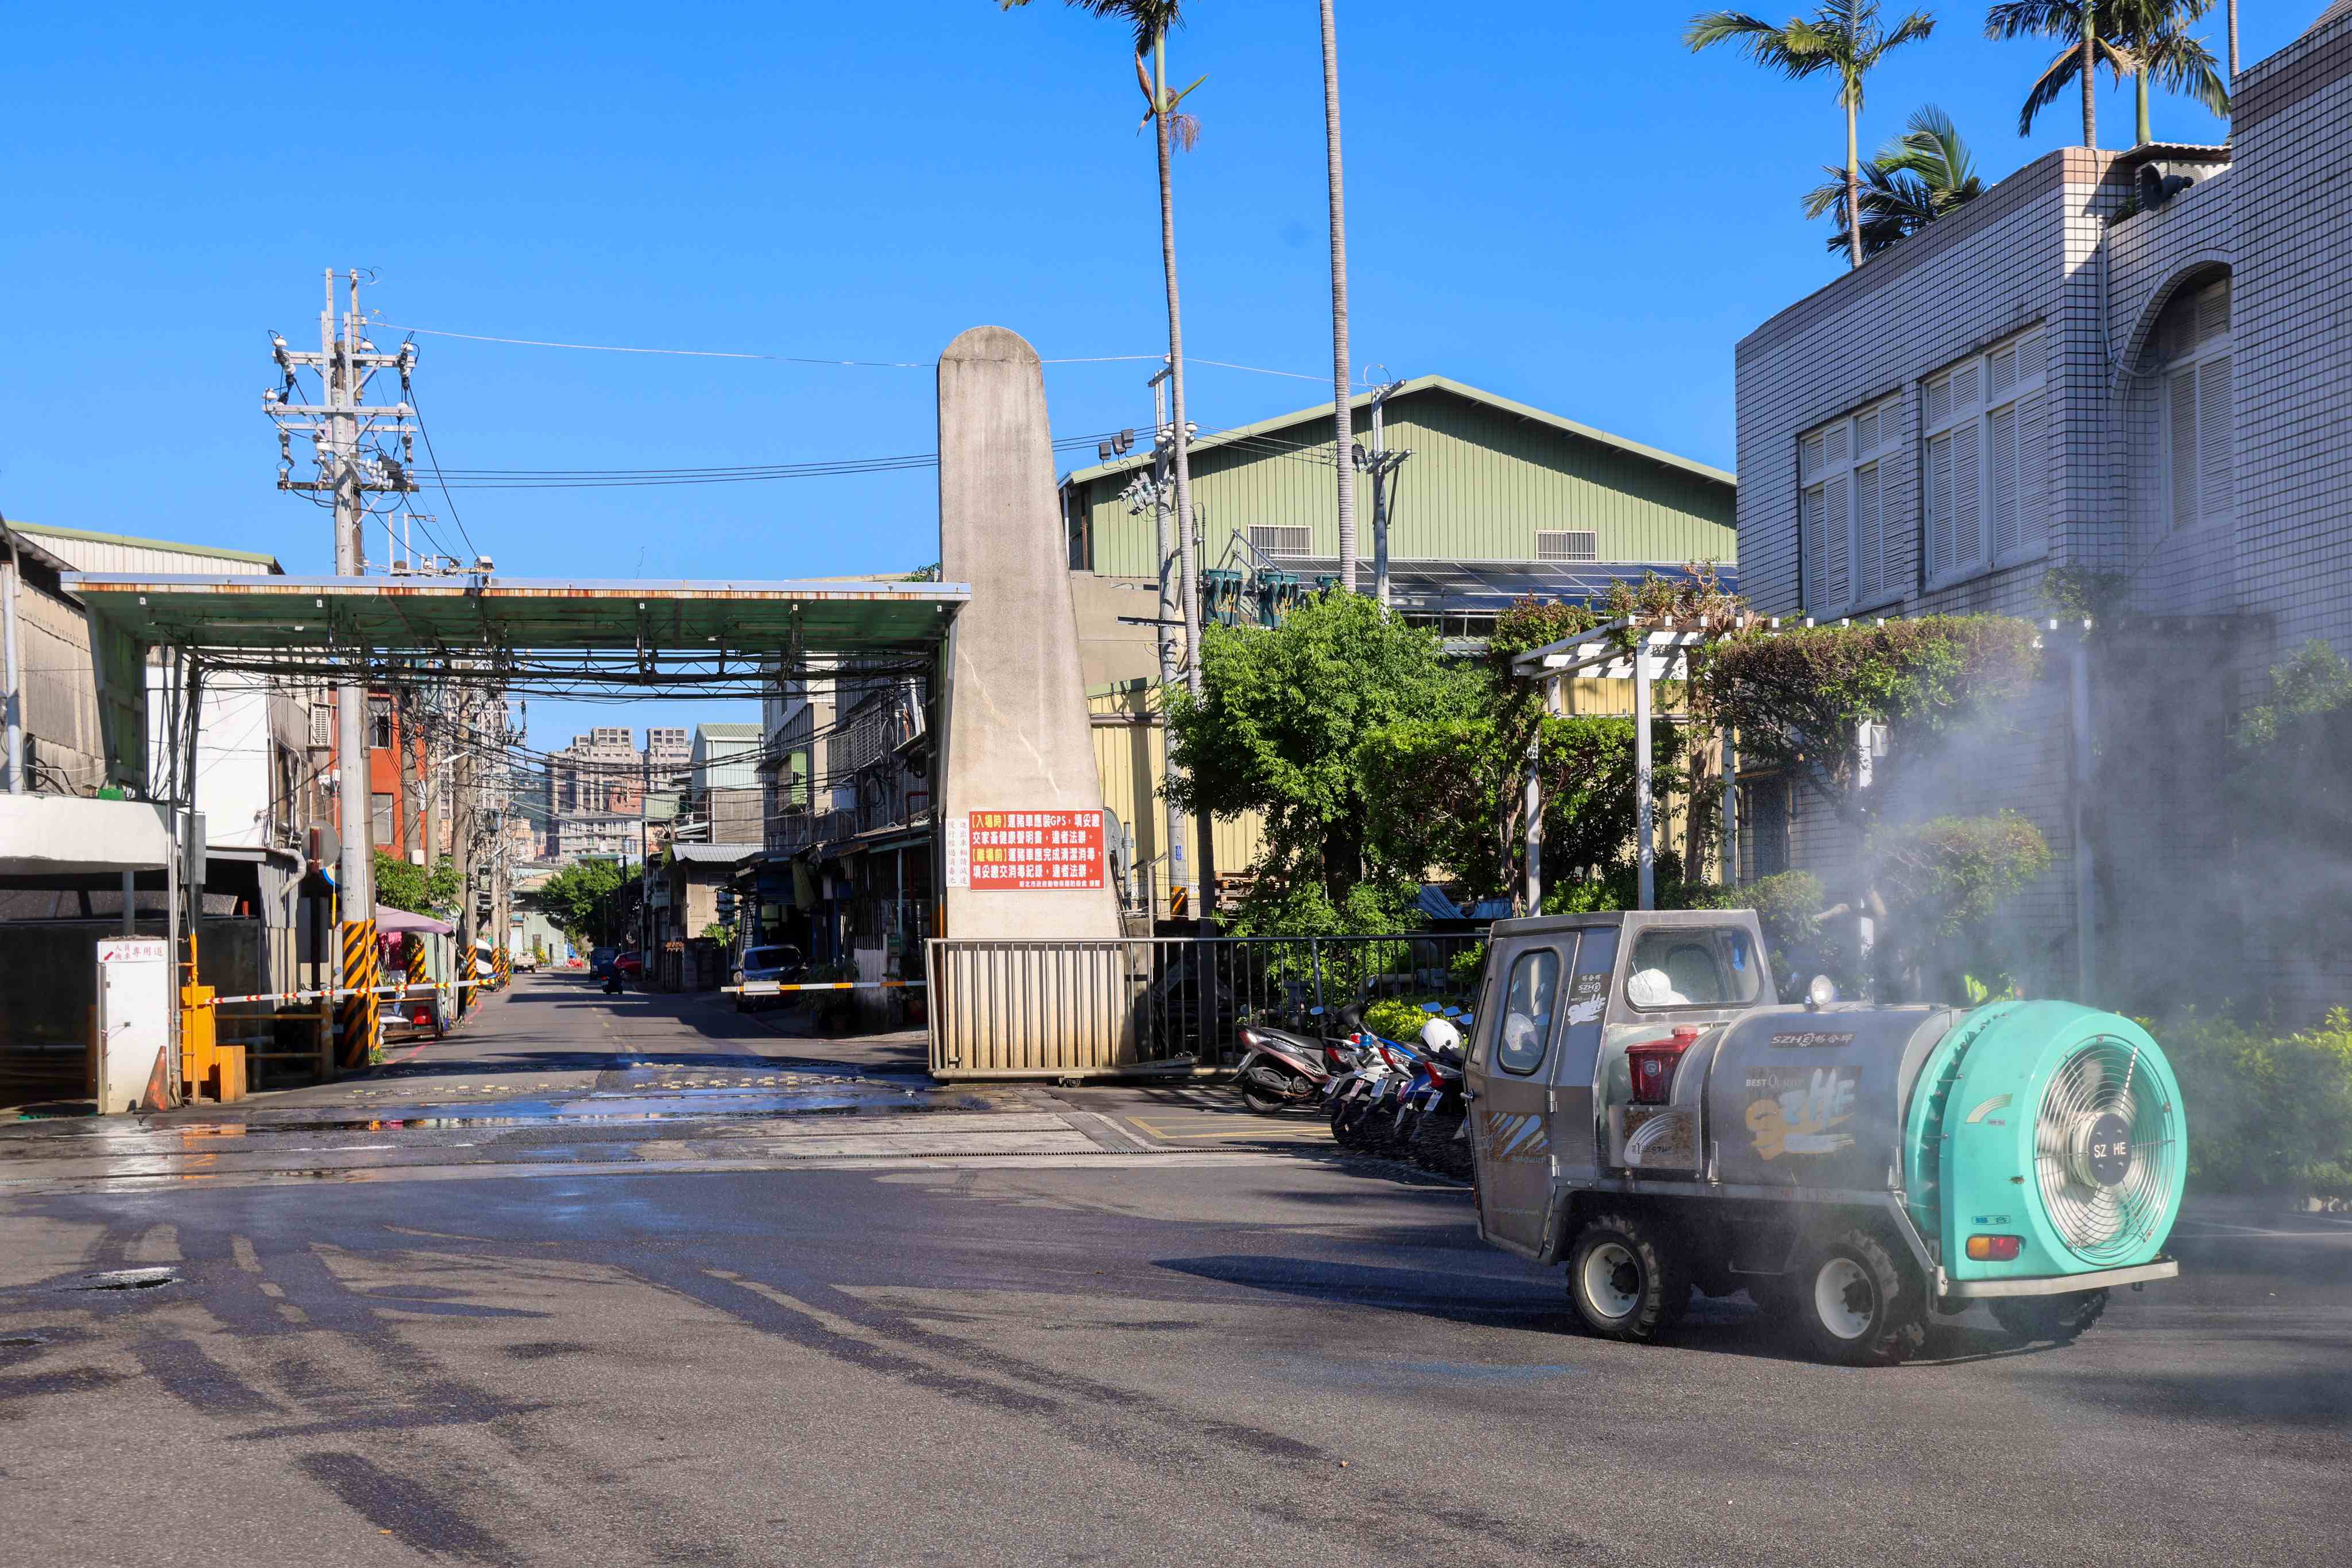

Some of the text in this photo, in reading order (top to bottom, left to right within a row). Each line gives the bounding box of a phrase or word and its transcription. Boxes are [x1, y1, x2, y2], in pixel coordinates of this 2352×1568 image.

[1746, 1079, 1767, 1087] BEST
[2094, 1142, 2126, 1158] SZ HE
